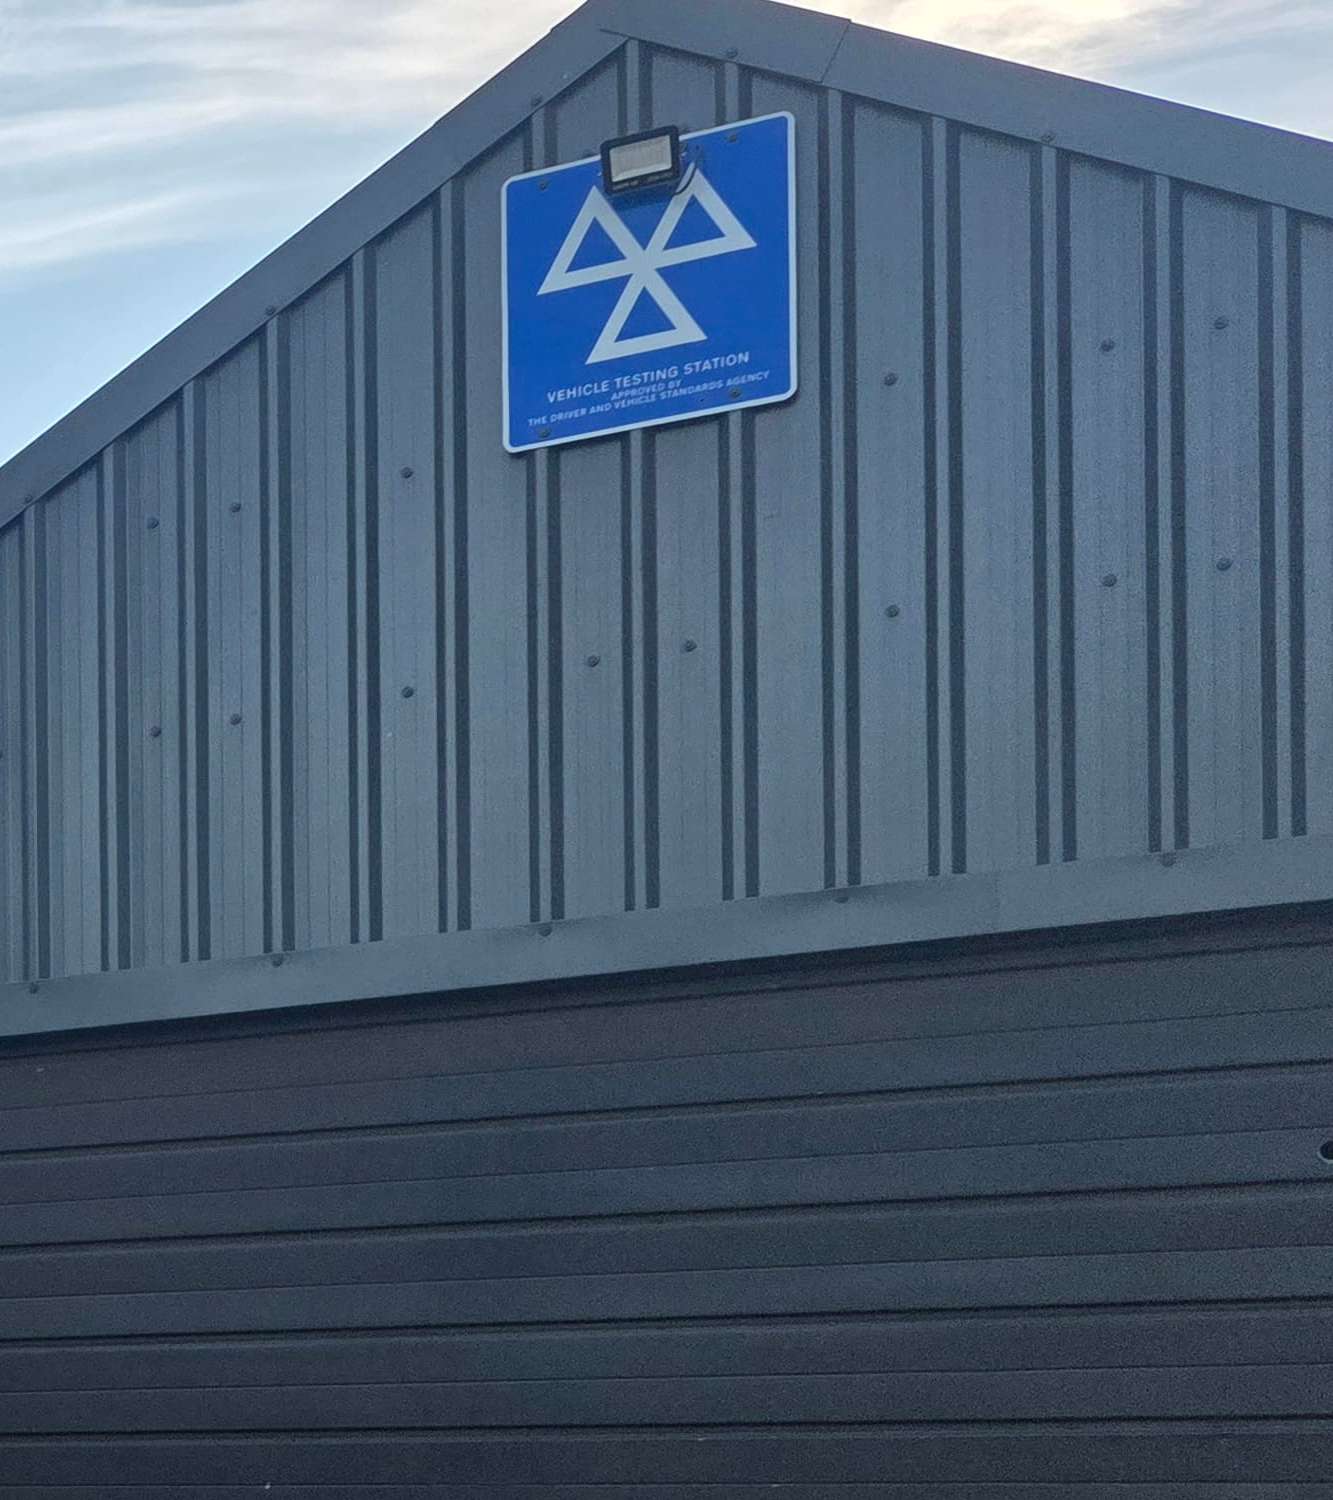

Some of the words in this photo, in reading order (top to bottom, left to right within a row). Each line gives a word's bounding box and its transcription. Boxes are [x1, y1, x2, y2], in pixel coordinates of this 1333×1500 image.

[528, 416, 548, 427] THE
[550, 408, 587, 423] DRIVER
[589, 402, 612, 415] AND
[614, 393, 657, 409] VEHICLE
[660, 379, 724, 400] STANDARDS
[726, 369, 771, 387] AGENCY
[547, 380, 610, 403] VEHICLE
[614, 365, 679, 389] TESTING
[684, 351, 750, 376] STATION
[611, 383, 666, 400] APPROVED
[668, 380, 682, 390] BY
